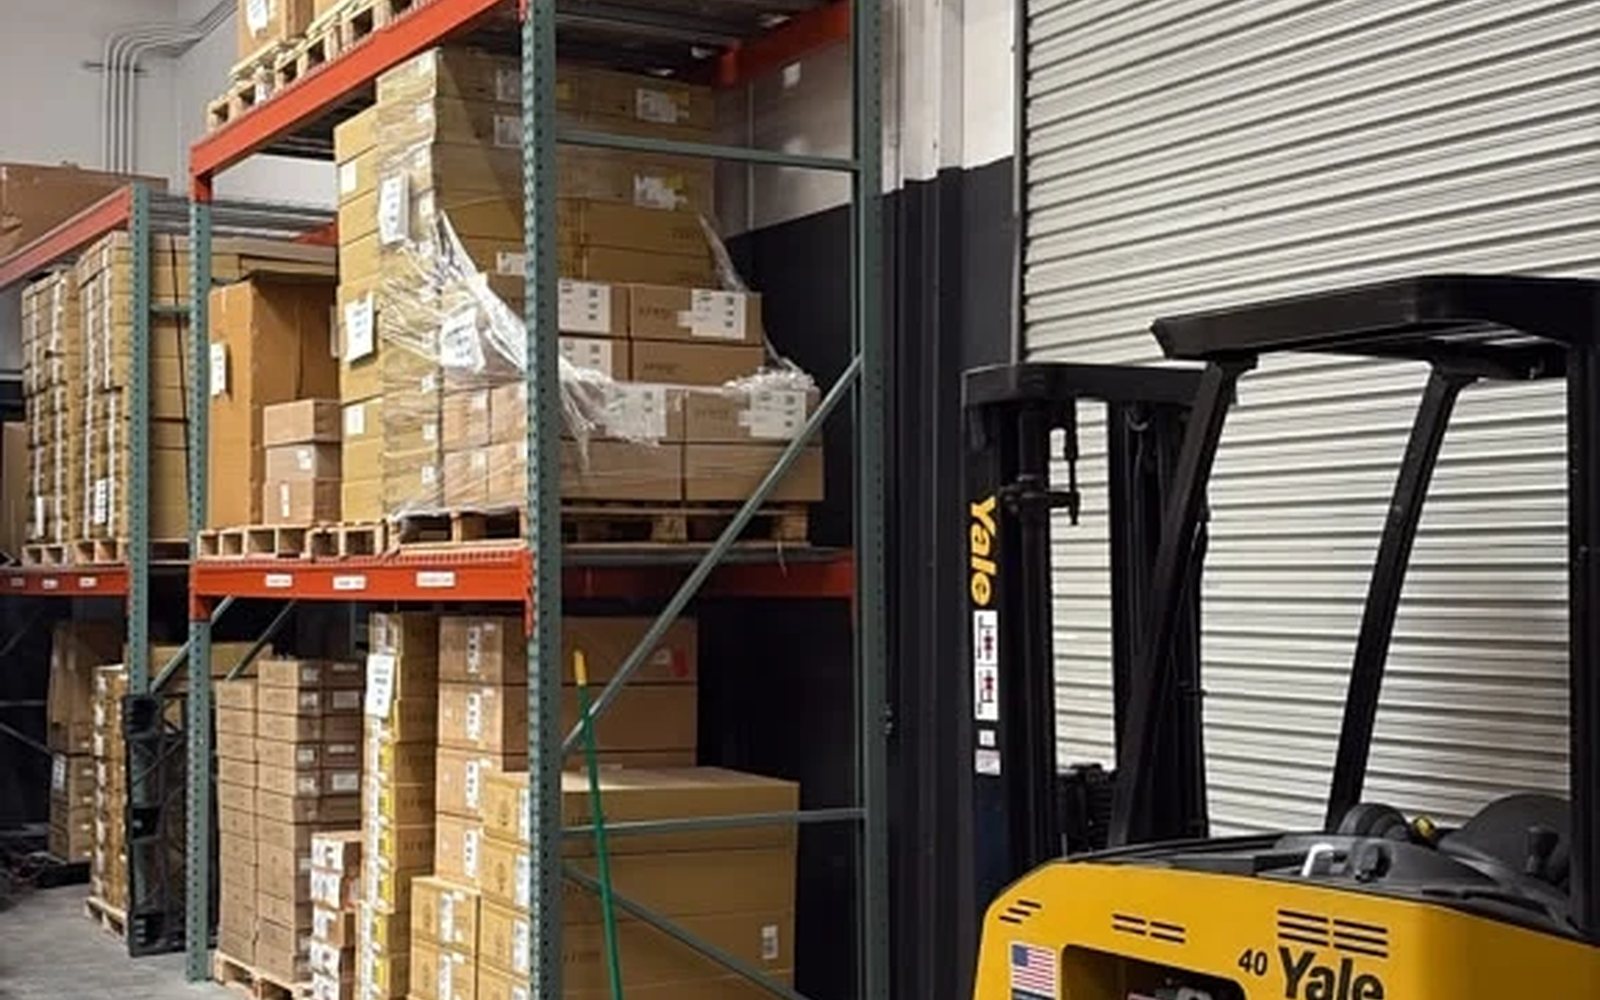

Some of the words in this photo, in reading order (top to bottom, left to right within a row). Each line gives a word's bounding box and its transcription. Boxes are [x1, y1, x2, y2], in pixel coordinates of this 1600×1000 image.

[970, 496, 997, 606] Yale
[1238, 949, 1268, 976] 40
[1278, 948, 1384, 1000] Yale
